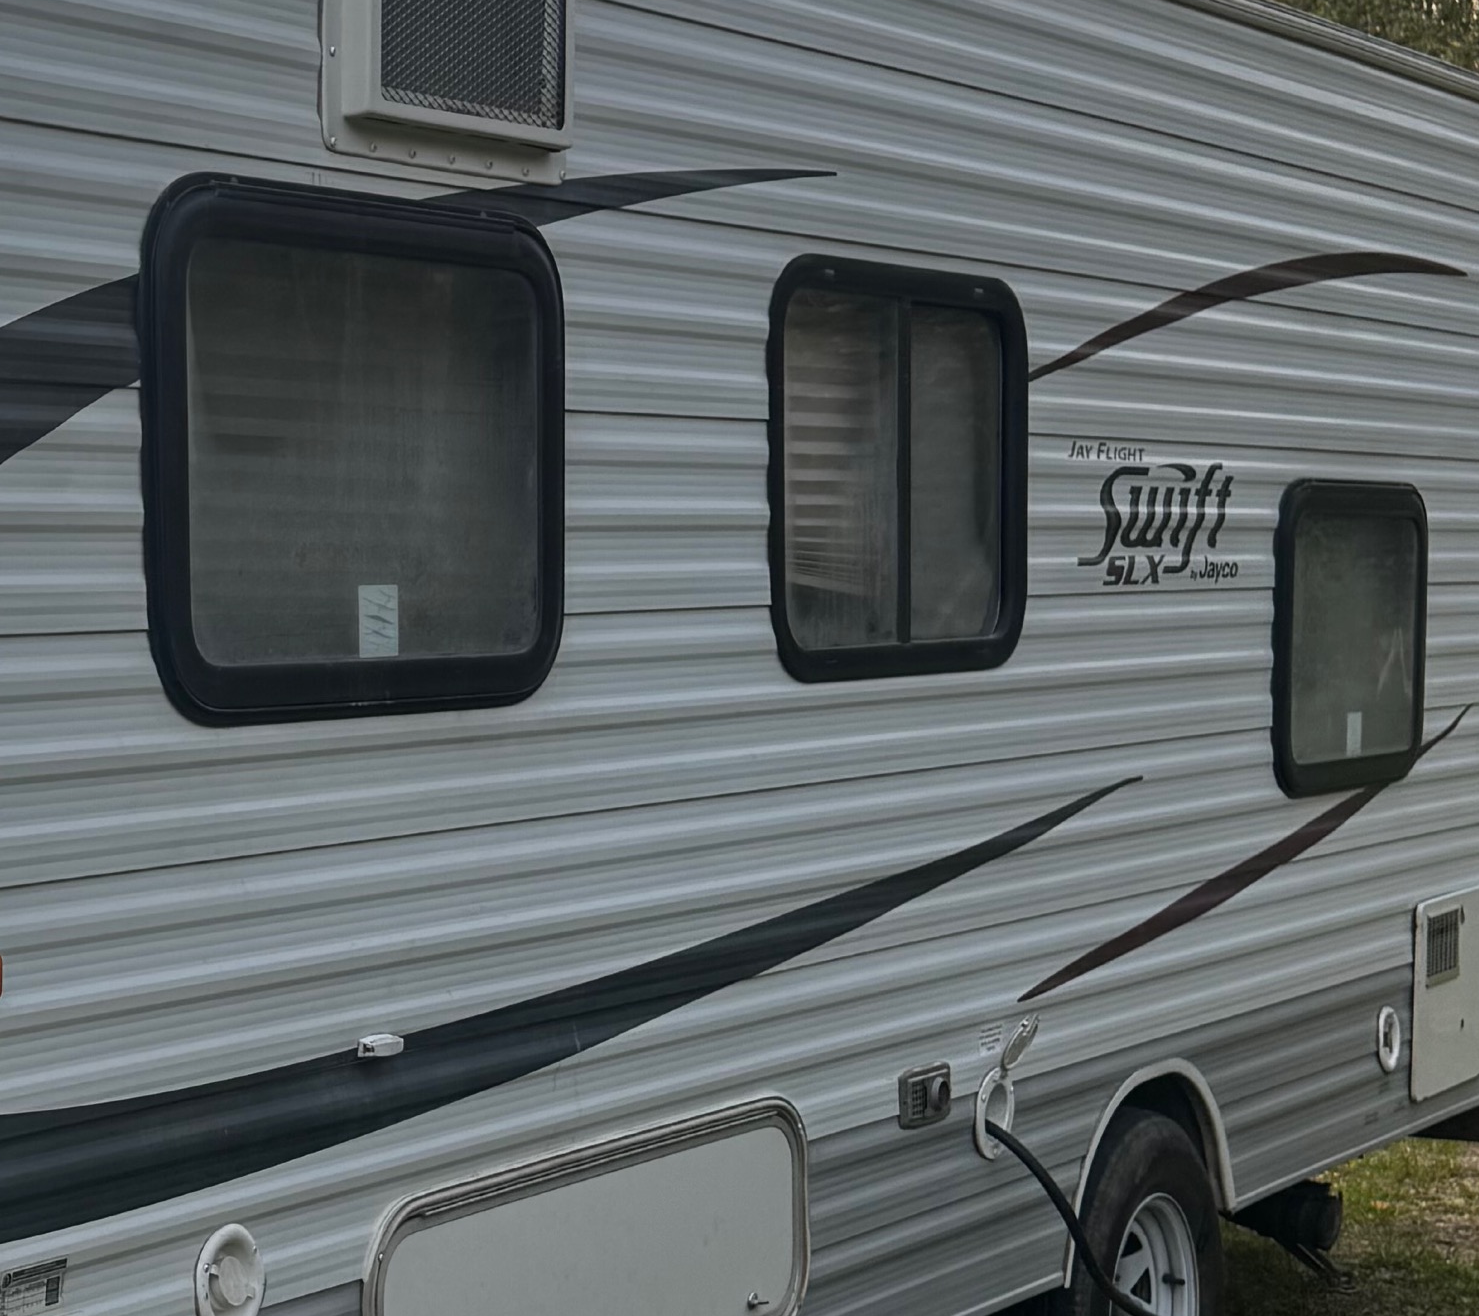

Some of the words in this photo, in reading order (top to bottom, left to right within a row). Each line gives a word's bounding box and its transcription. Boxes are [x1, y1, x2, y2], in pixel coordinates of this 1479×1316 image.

[1068, 440, 1093, 459] JAY
[1096, 442, 1146, 462] FLIGHT
[1077, 462, 1234, 574] Swift
[1102, 554, 1166, 586] SLX
[1199, 555, 1239, 585] Jayco
